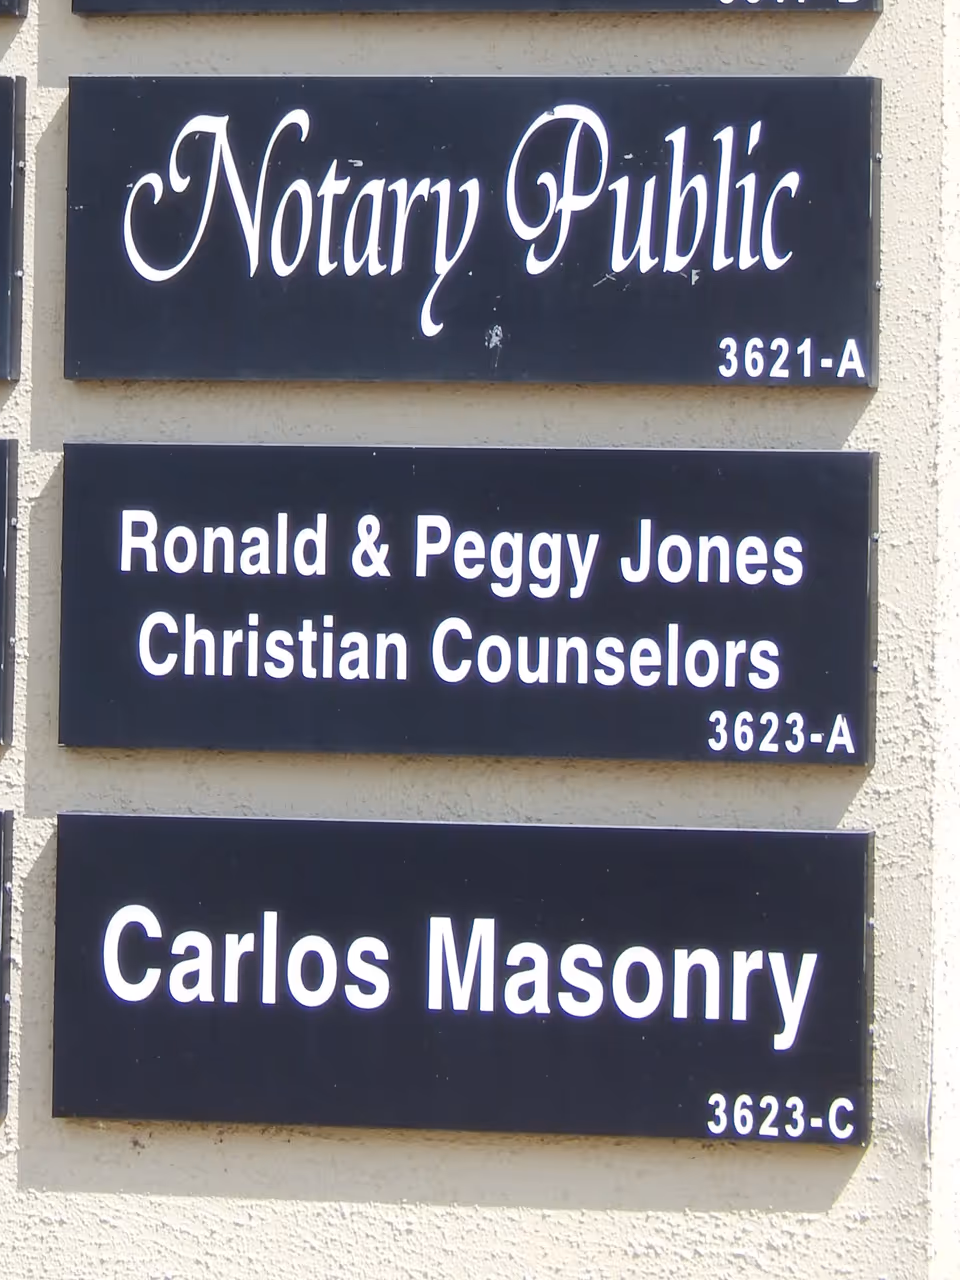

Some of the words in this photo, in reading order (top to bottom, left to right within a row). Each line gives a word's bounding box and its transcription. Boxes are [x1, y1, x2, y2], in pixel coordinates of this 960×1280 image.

[123, 108, 480, 338] Notary
[506, 103, 800, 276] Public
[718, 336, 866, 379] 3621-A
[120, 509, 328, 577] Ronald
[351, 514, 391, 578] &
[415, 514, 600, 599] Peggy
[620, 518, 804, 586] Jones
[138, 610, 408, 681] Christian
[431, 616, 780, 690] Counselors
[707, 710, 856, 755] 3623-A
[103, 904, 390, 1010] Carlos
[427, 916, 818, 1051] Masonry
[707, 1092, 855, 1141] 3623-C
